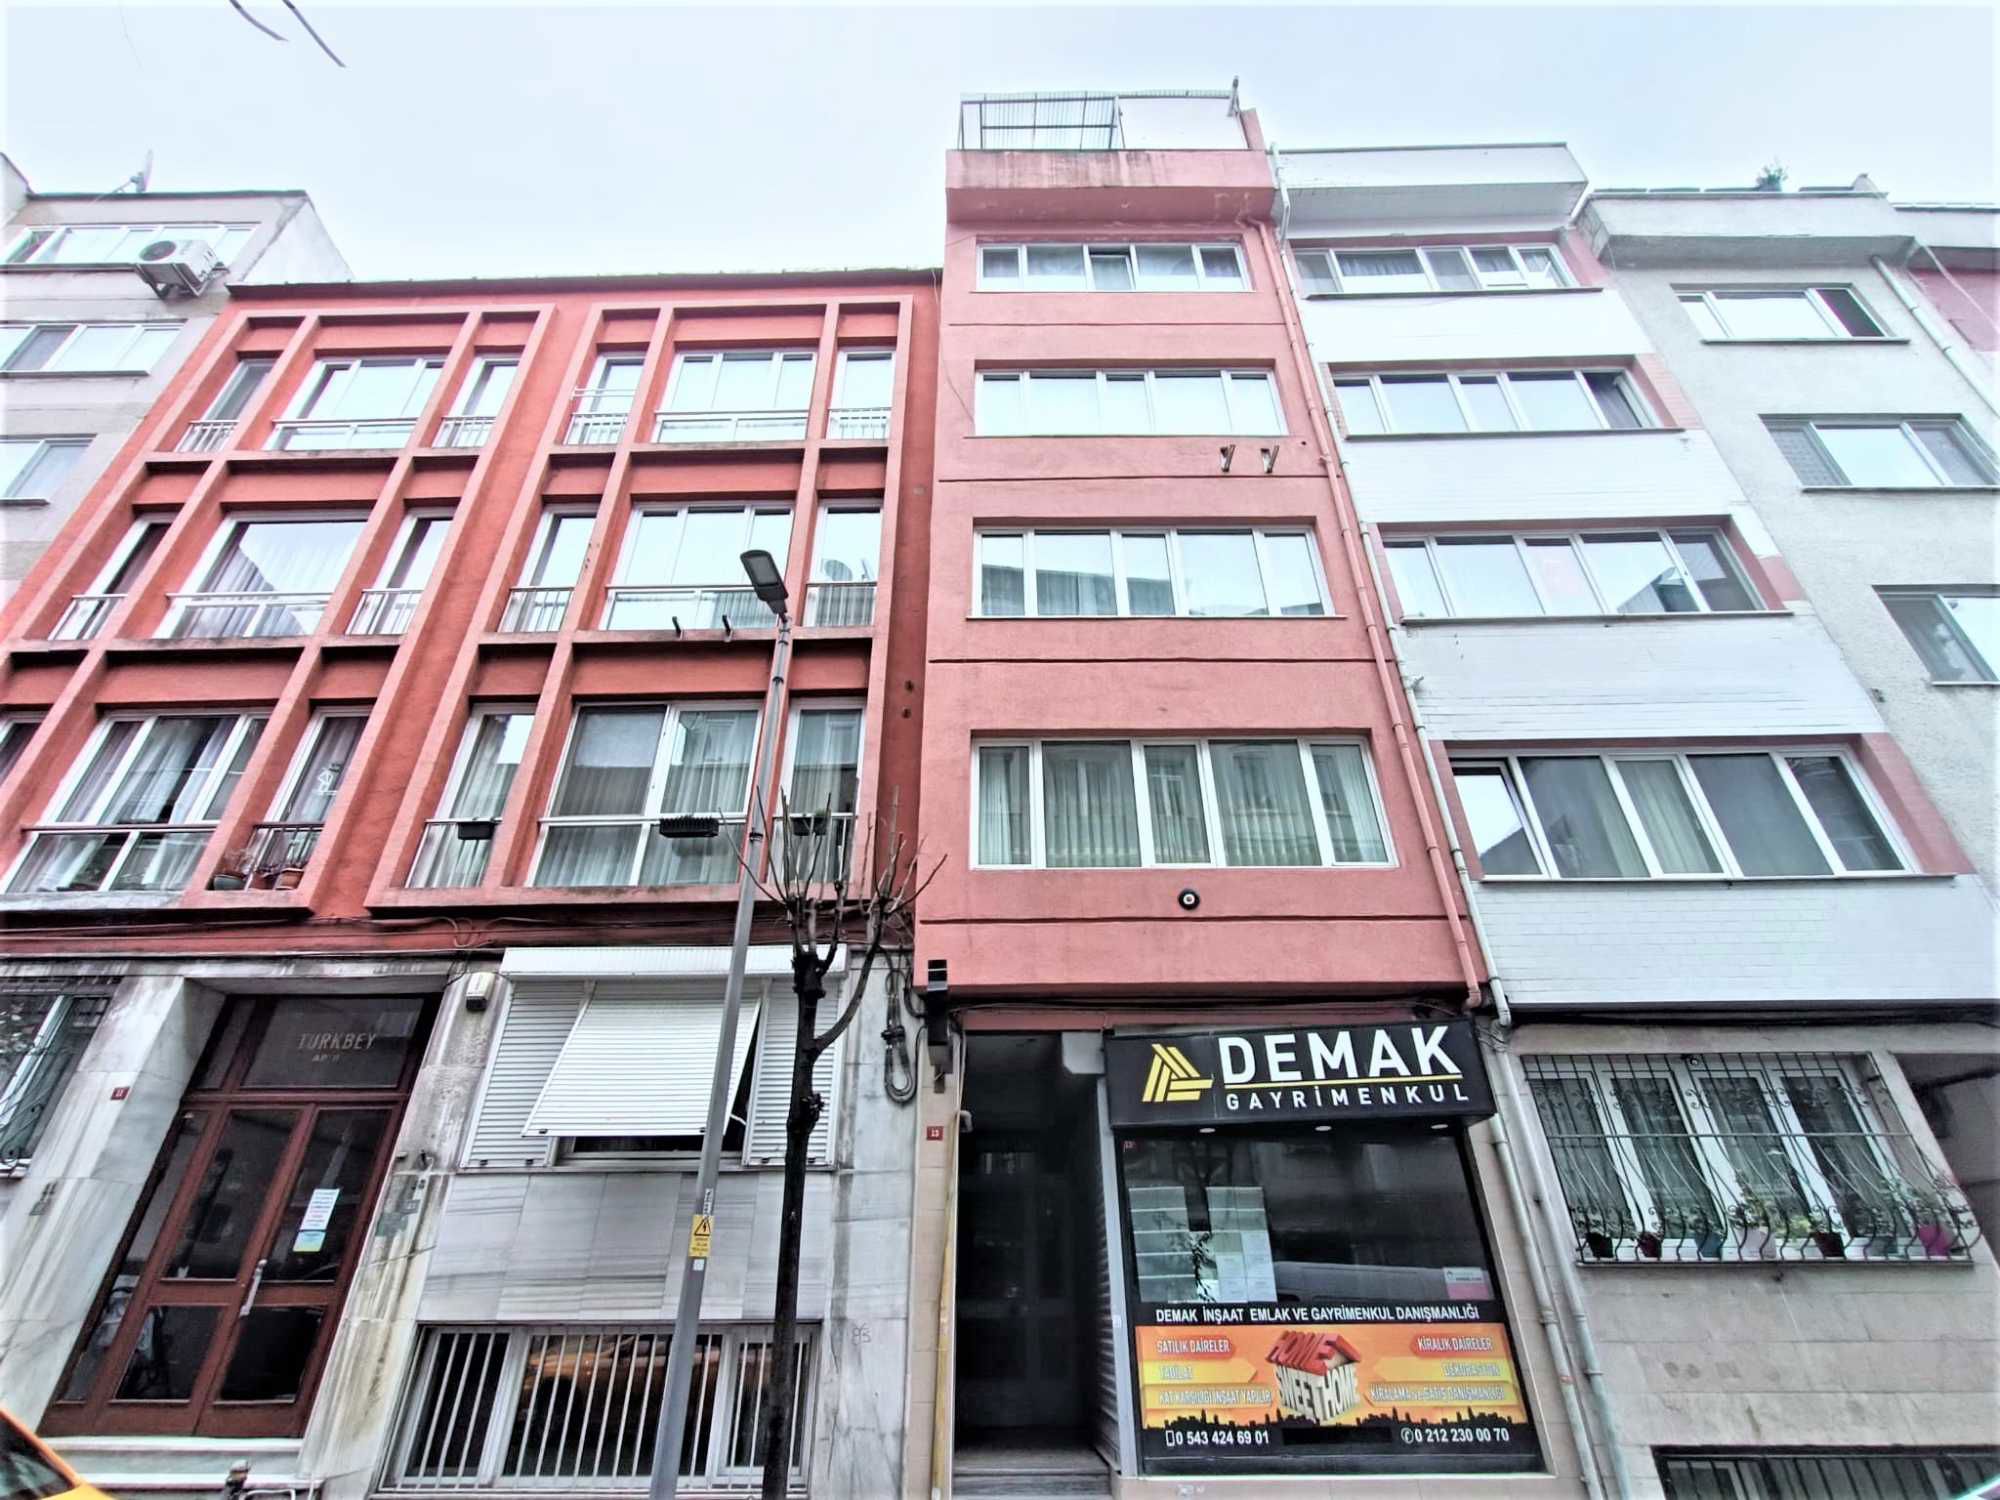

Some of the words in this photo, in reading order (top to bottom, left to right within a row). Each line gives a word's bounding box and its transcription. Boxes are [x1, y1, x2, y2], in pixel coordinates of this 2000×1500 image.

[1218, 1025, 1462, 1085] DEMAK
[1226, 1083, 1469, 1111] GAYRİMENKUL
[1156, 1309, 1198, 1322] DEMAK
[1203, 1306, 1244, 1324] İNŞAAT
[1250, 1308, 1291, 1321] EMLAK
[1292, 1307, 1308, 1320] VE
[1311, 1304, 1394, 1320] GAYRİMENKUL
[1396, 1303, 1480, 1322] DANIŞMANLIĞI
[1157, 1340, 1188, 1353] SATILIK
[1190, 1338, 1231, 1353] DAİRELER
[1417, 1336, 1450, 1351] KİRALIK
[1175, 1430, 1183, 1445] 0
[1186, 1430, 1208, 1445] 543
[1211, 1430, 1234, 1444] 424
[1237, 1430, 1251, 1444] 69
[1255, 1430, 1269, 1444] 01
[1414, 1428, 1423, 1443] 0
[1425, 1428, 1449, 1442] 212
[1450, 1428, 1474, 1442] 230
[1475, 1428, 1491, 1442] 00
[1493, 1428, 1509, 1441] 70
